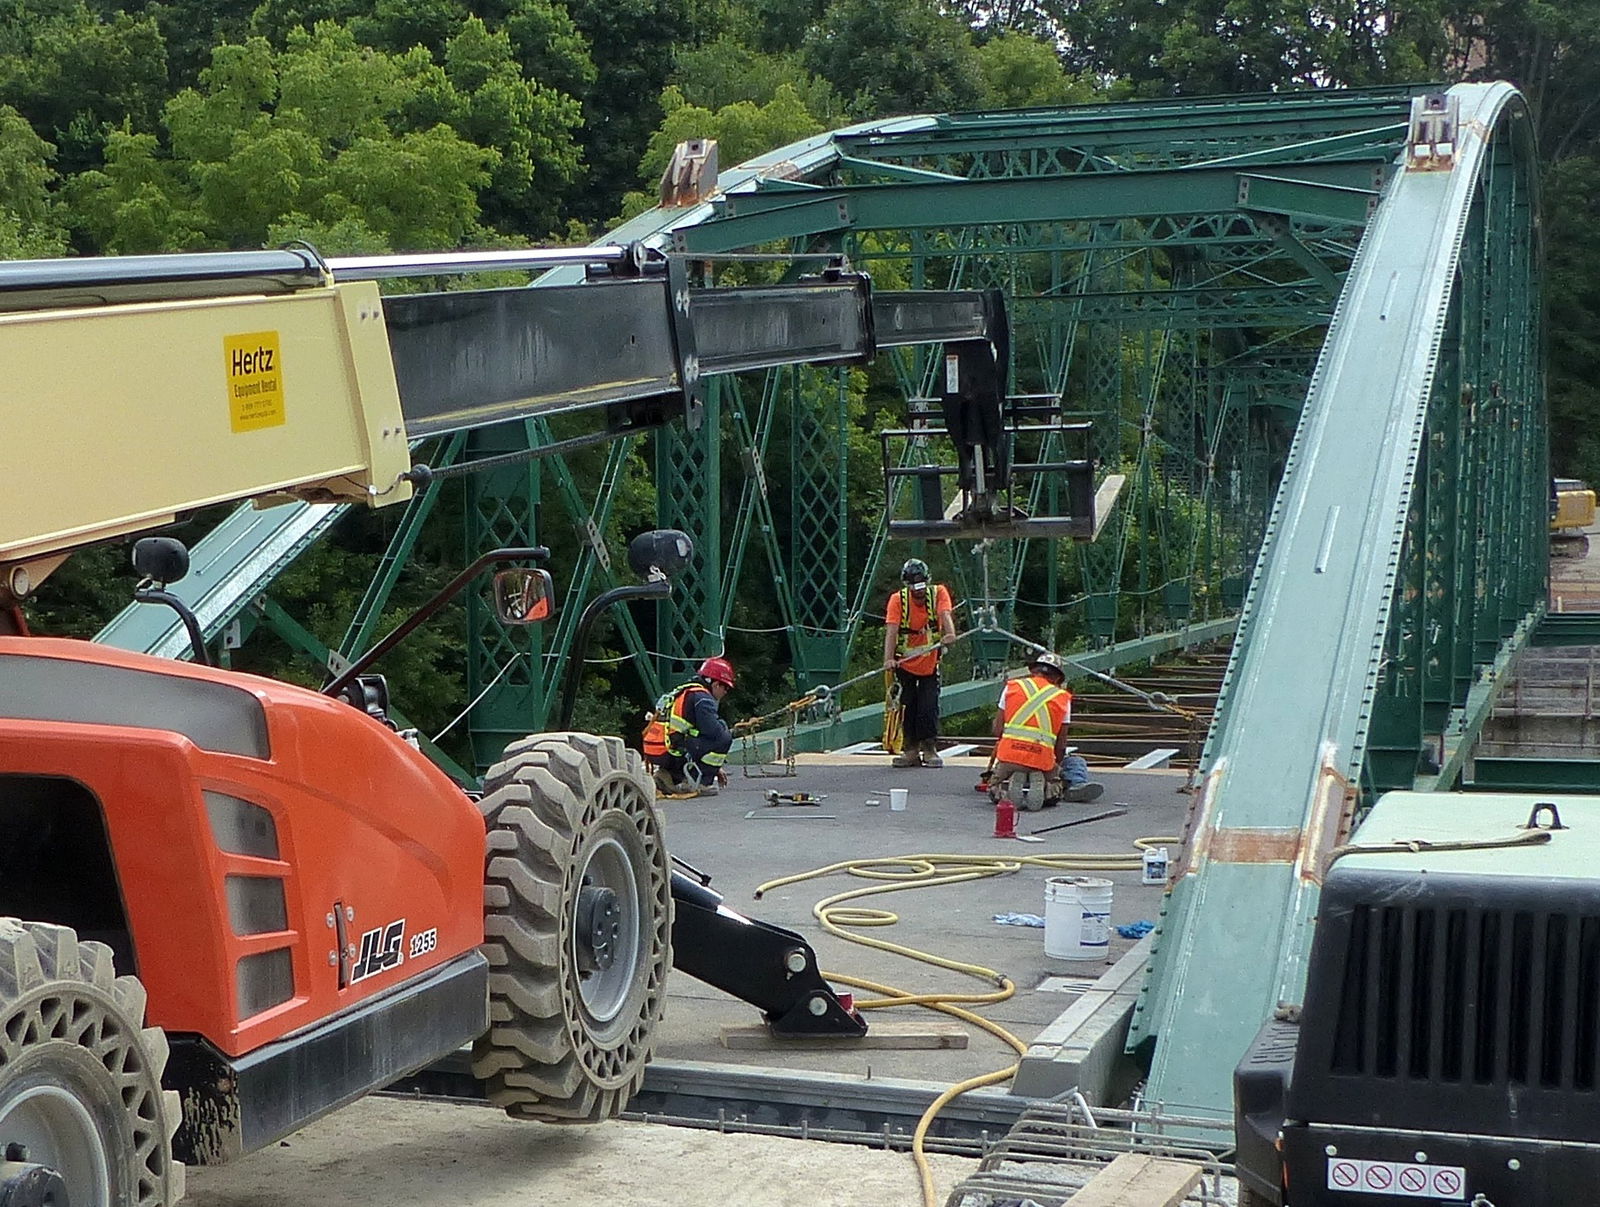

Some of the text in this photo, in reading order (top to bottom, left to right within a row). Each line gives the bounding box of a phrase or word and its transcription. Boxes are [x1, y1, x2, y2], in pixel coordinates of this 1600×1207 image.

[232, 346, 273, 376] Hertz
[350, 918, 437, 985] JLG 1255
